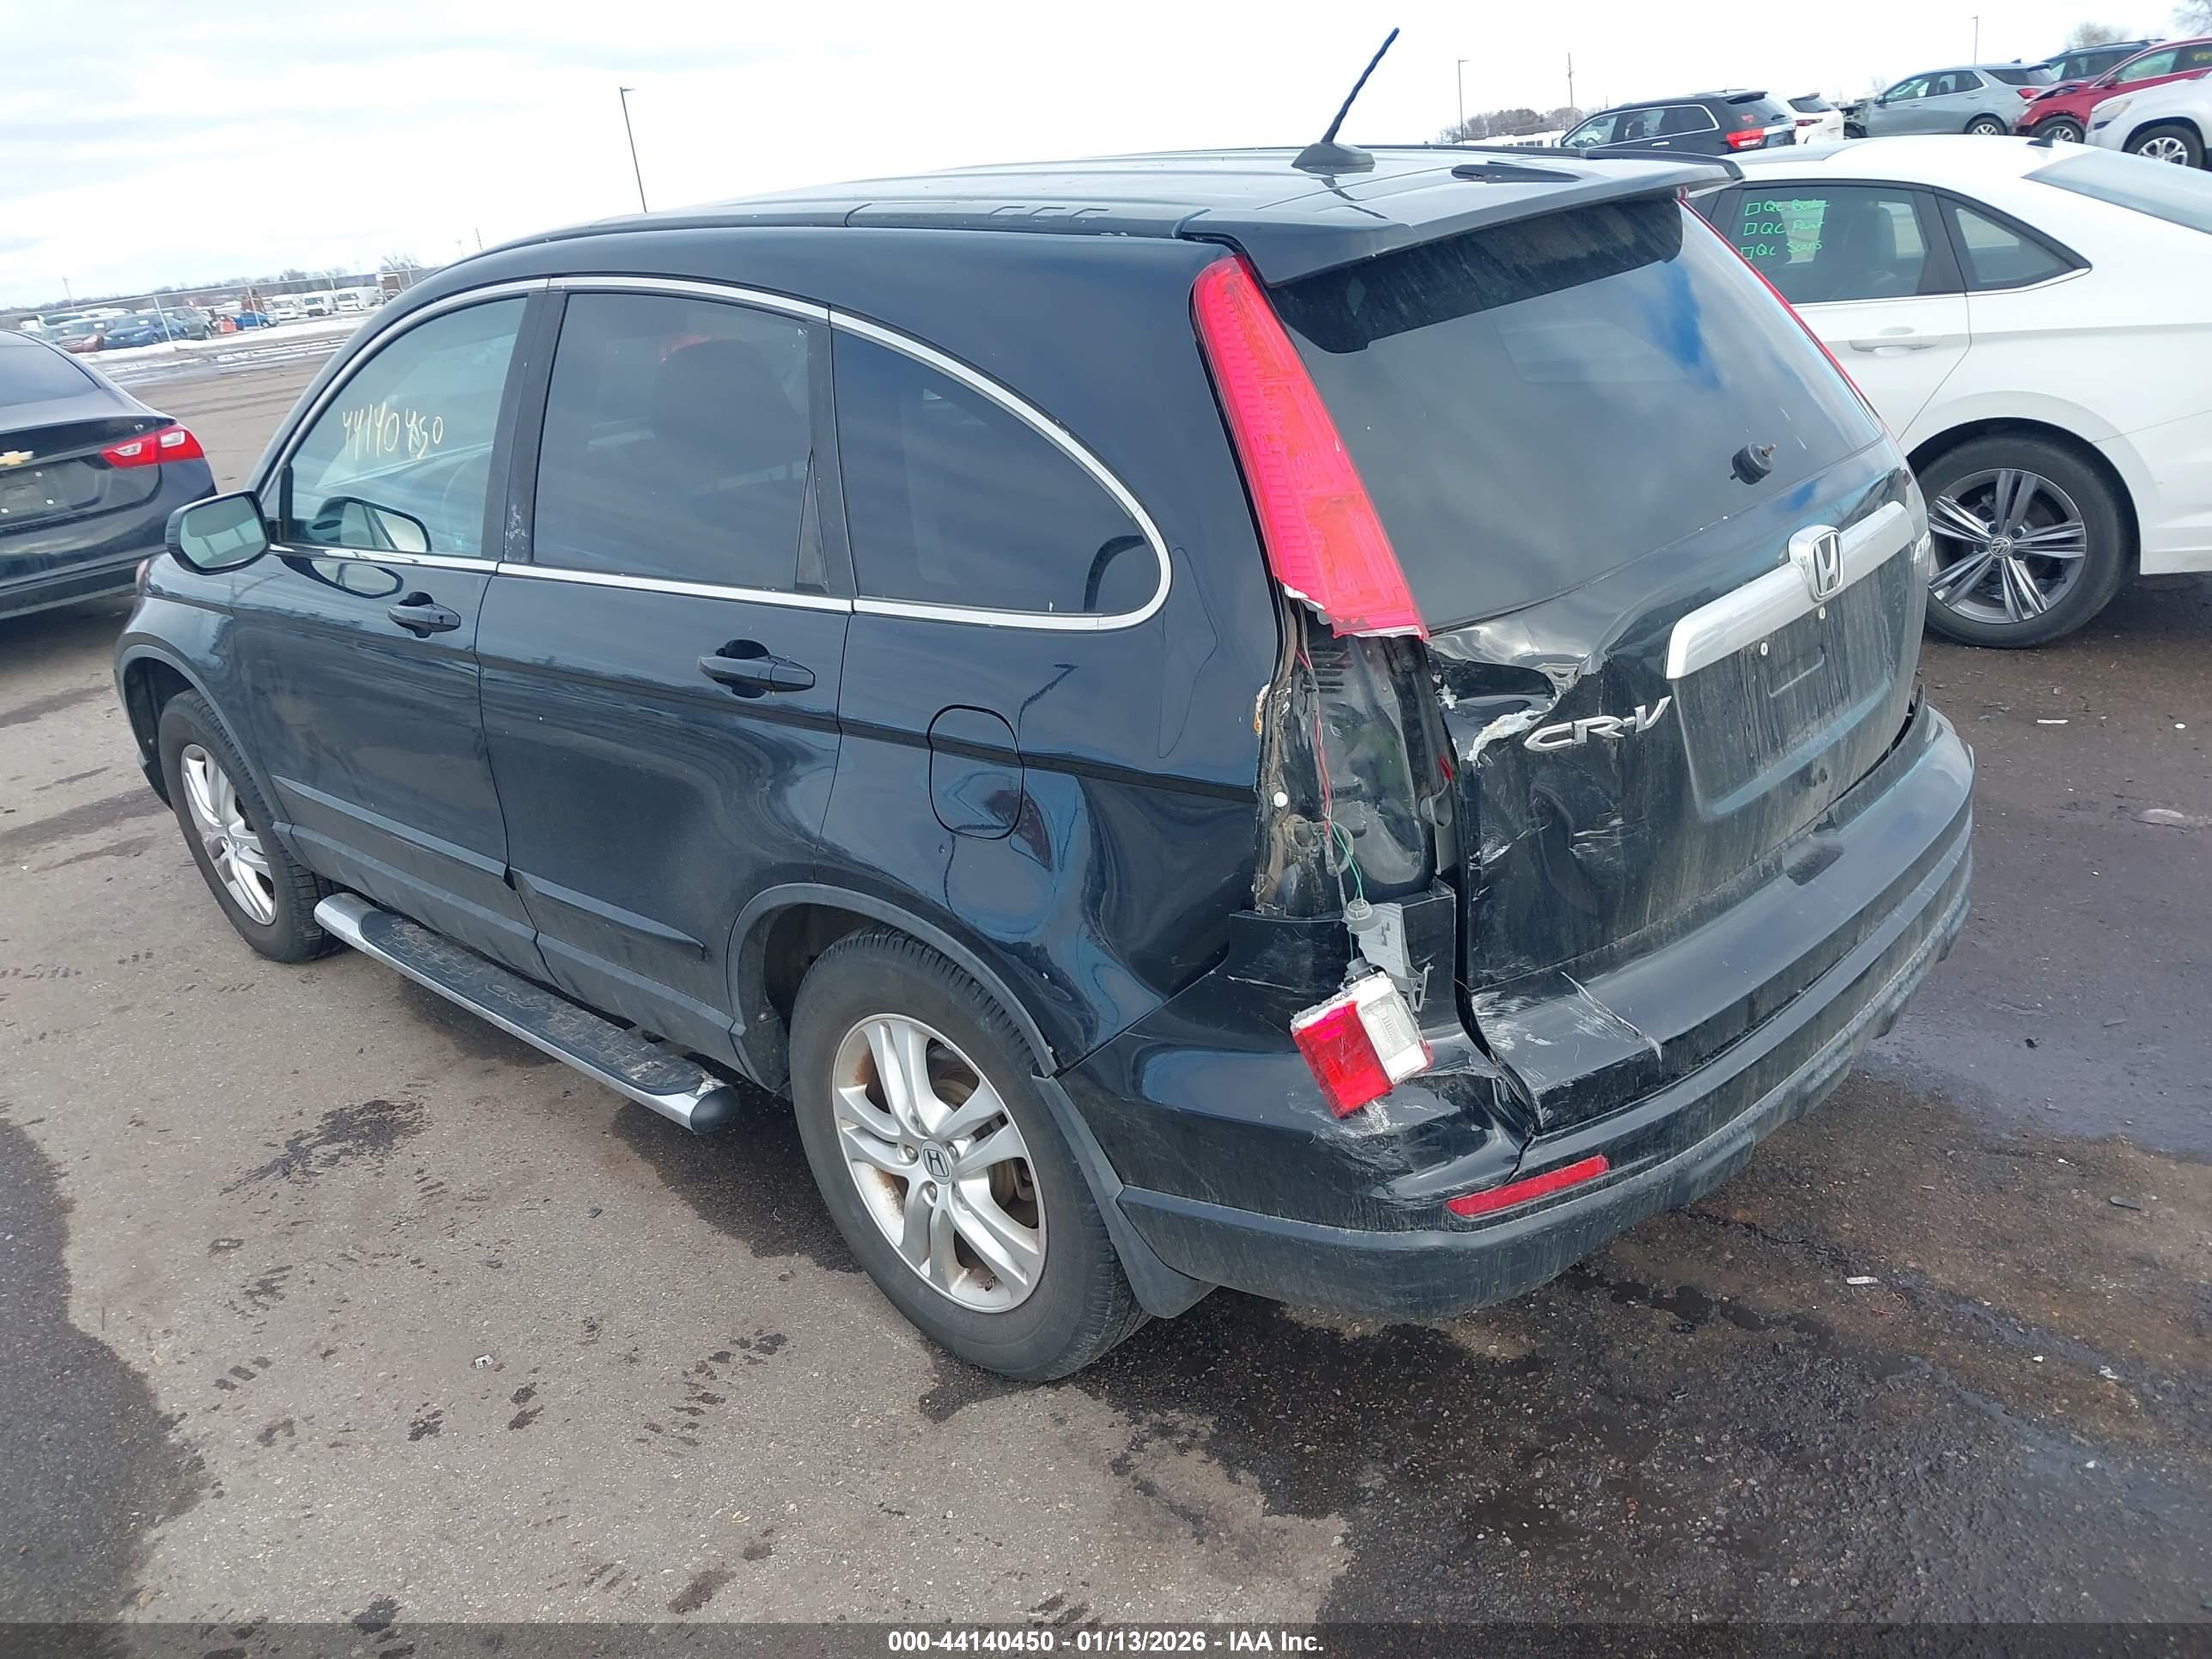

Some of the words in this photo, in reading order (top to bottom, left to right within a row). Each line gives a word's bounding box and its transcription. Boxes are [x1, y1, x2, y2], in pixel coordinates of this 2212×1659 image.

[1760, 222, 1786, 234] QC
[1756, 243, 1777, 256] QC
[1523, 695, 1673, 753] CR-V
